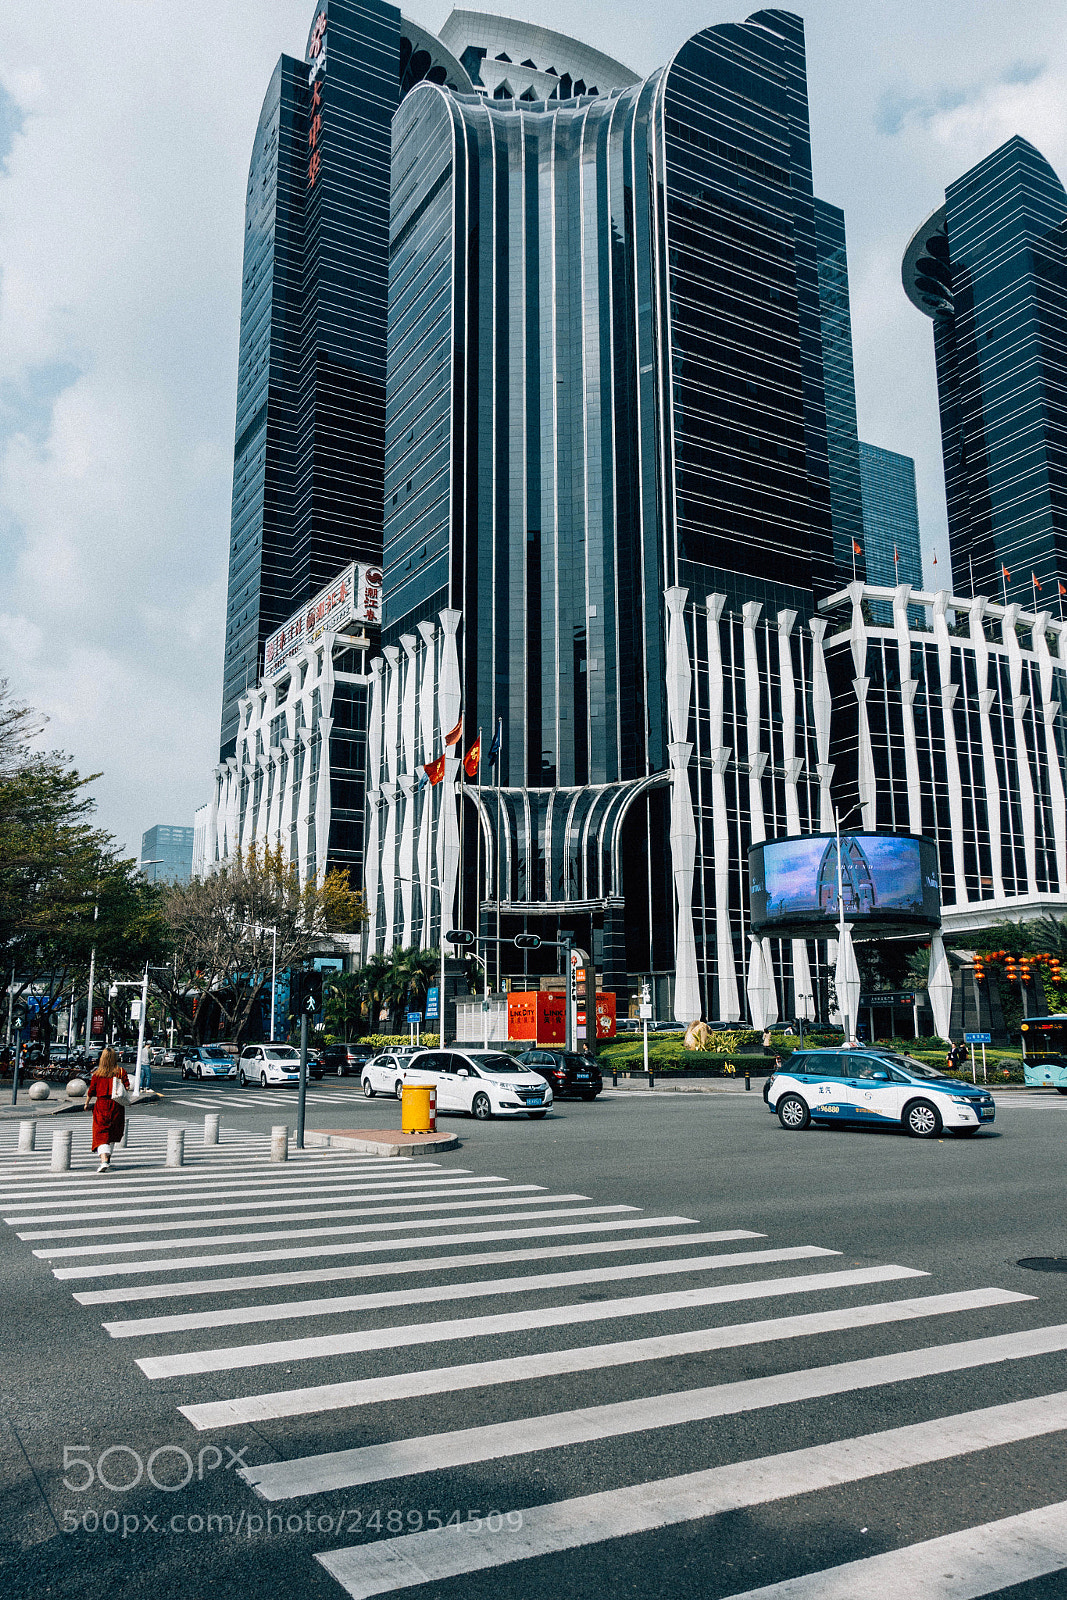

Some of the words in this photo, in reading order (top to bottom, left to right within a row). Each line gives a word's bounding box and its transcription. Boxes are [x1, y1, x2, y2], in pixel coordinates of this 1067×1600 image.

[363, 587, 378, 621] 潮江春
[543, 1009, 563, 1017] LINK
